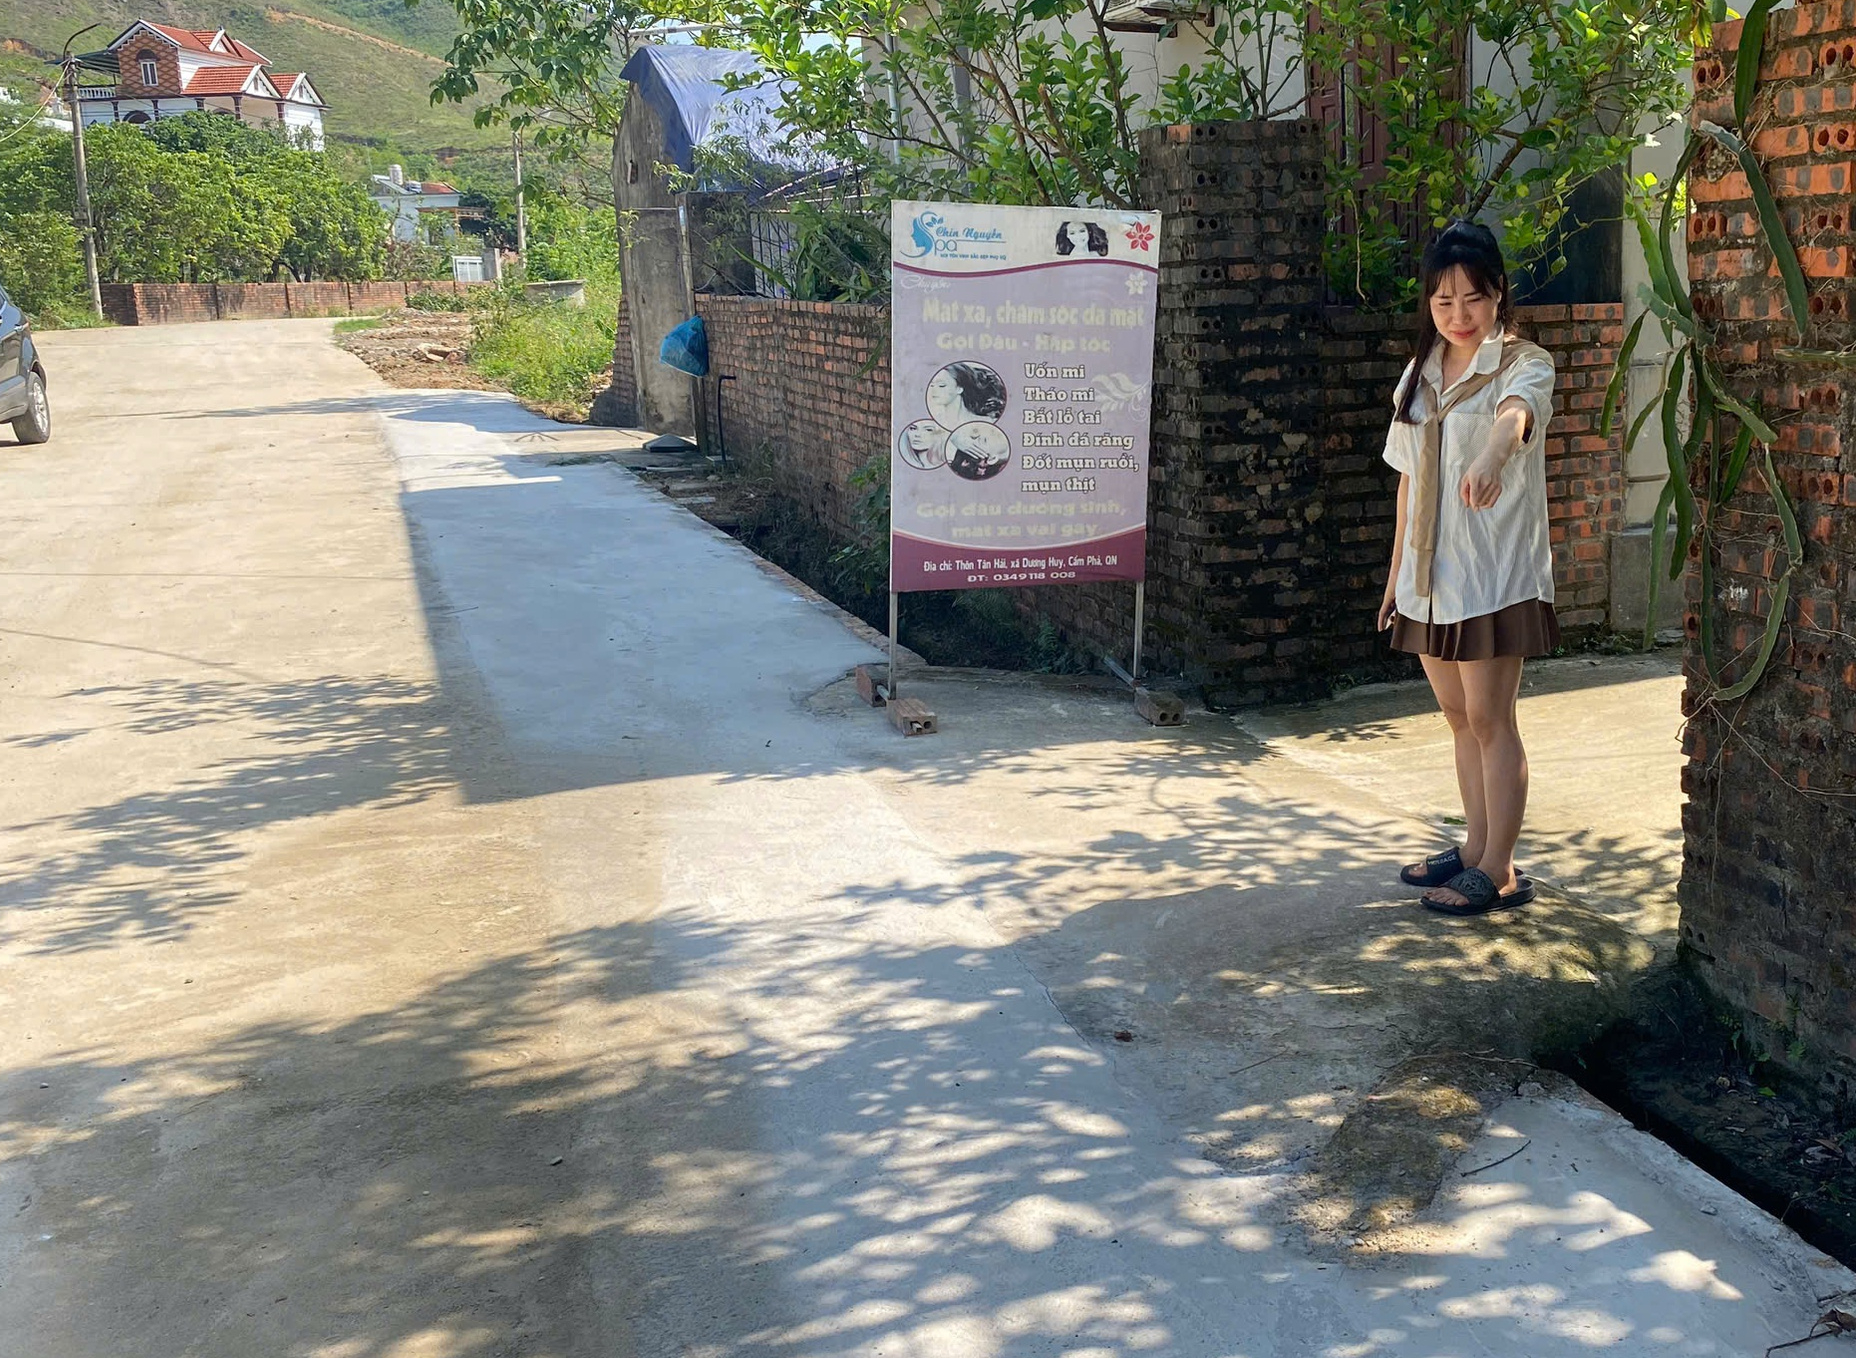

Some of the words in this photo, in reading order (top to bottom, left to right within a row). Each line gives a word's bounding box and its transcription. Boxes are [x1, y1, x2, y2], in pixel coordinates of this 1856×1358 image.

[1024, 362, 1058, 378] Uốn
[1061, 365, 1085, 378] mi
[1024, 387, 1068, 402] Tháo
[1071, 388, 1095, 402] mi
[1077, 410, 1101, 424] tai
[1022, 432, 1064, 447] Đính
[1068, 432, 1090, 447] đá
[1093, 432, 1134, 450] răng
[1022, 453, 1053, 470] Đốt
[1055, 458, 1096, 472] mụn
[1021, 481, 1062, 494] mụn
[1065, 477, 1096, 494] thịt
[1050, 571, 1076, 579] 008
